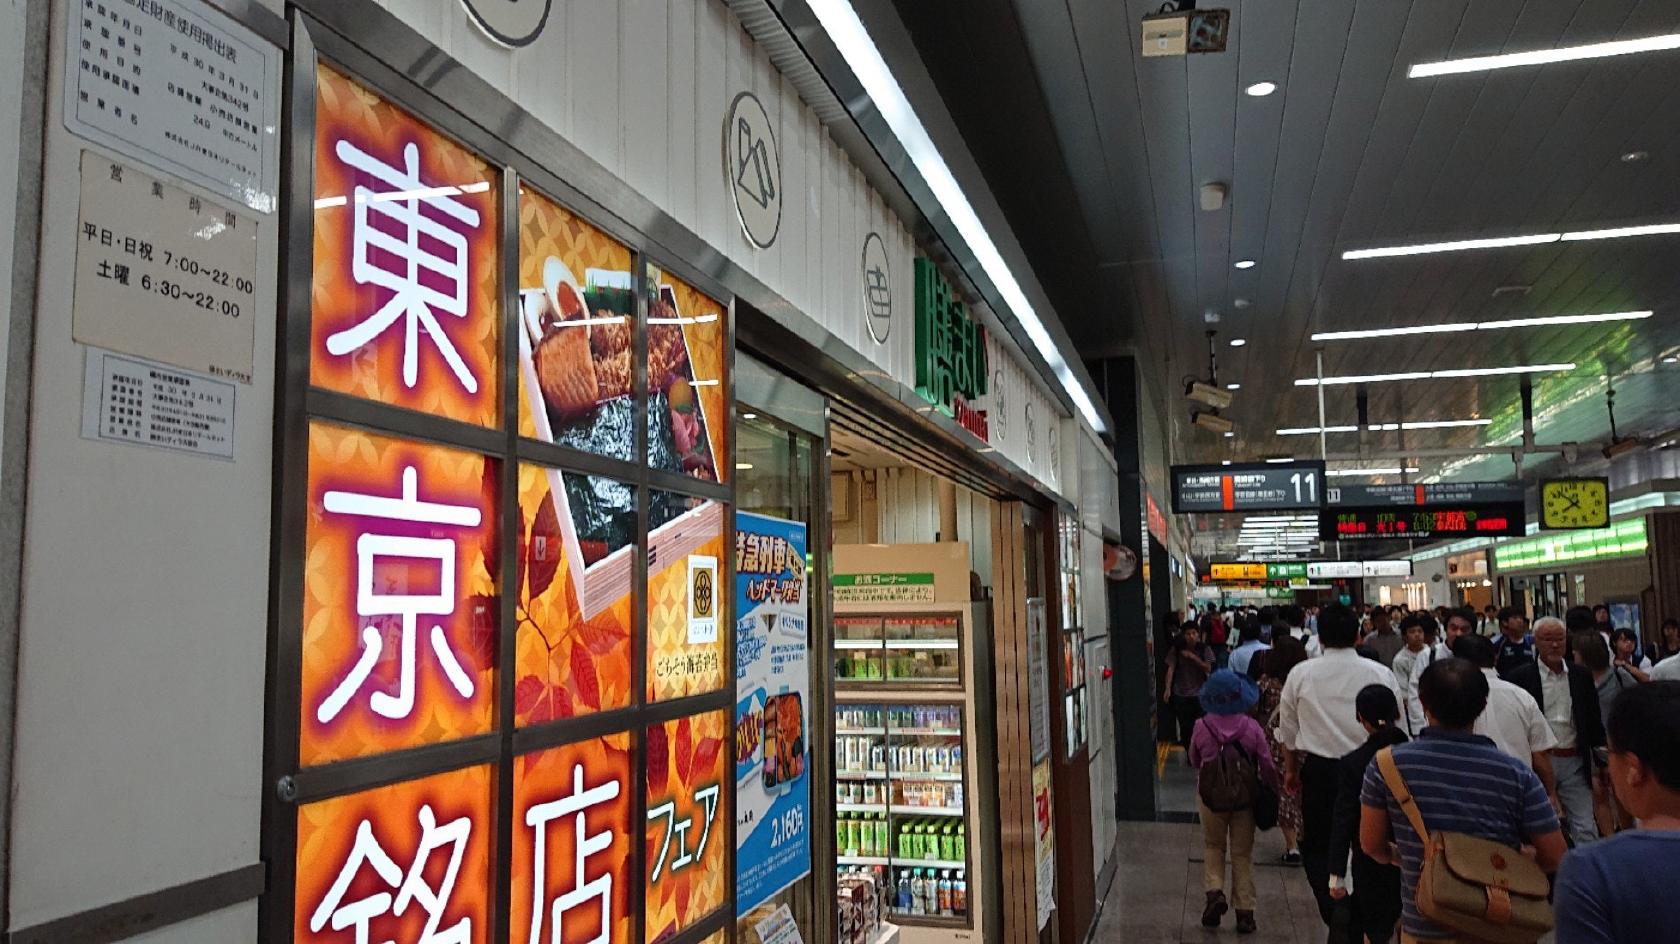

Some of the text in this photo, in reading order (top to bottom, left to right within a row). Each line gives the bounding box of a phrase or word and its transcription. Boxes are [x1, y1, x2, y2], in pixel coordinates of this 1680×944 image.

[124, 0, 237, 64] 定財産使用掲出表
[110, 163, 236, 229] 営業時間
[82, 221, 154, 262] 平日・日祝
[97, 259, 130, 286] 土曜
[1290, 472, 1316, 503] 11
[647, 785, 720, 882] フェア
